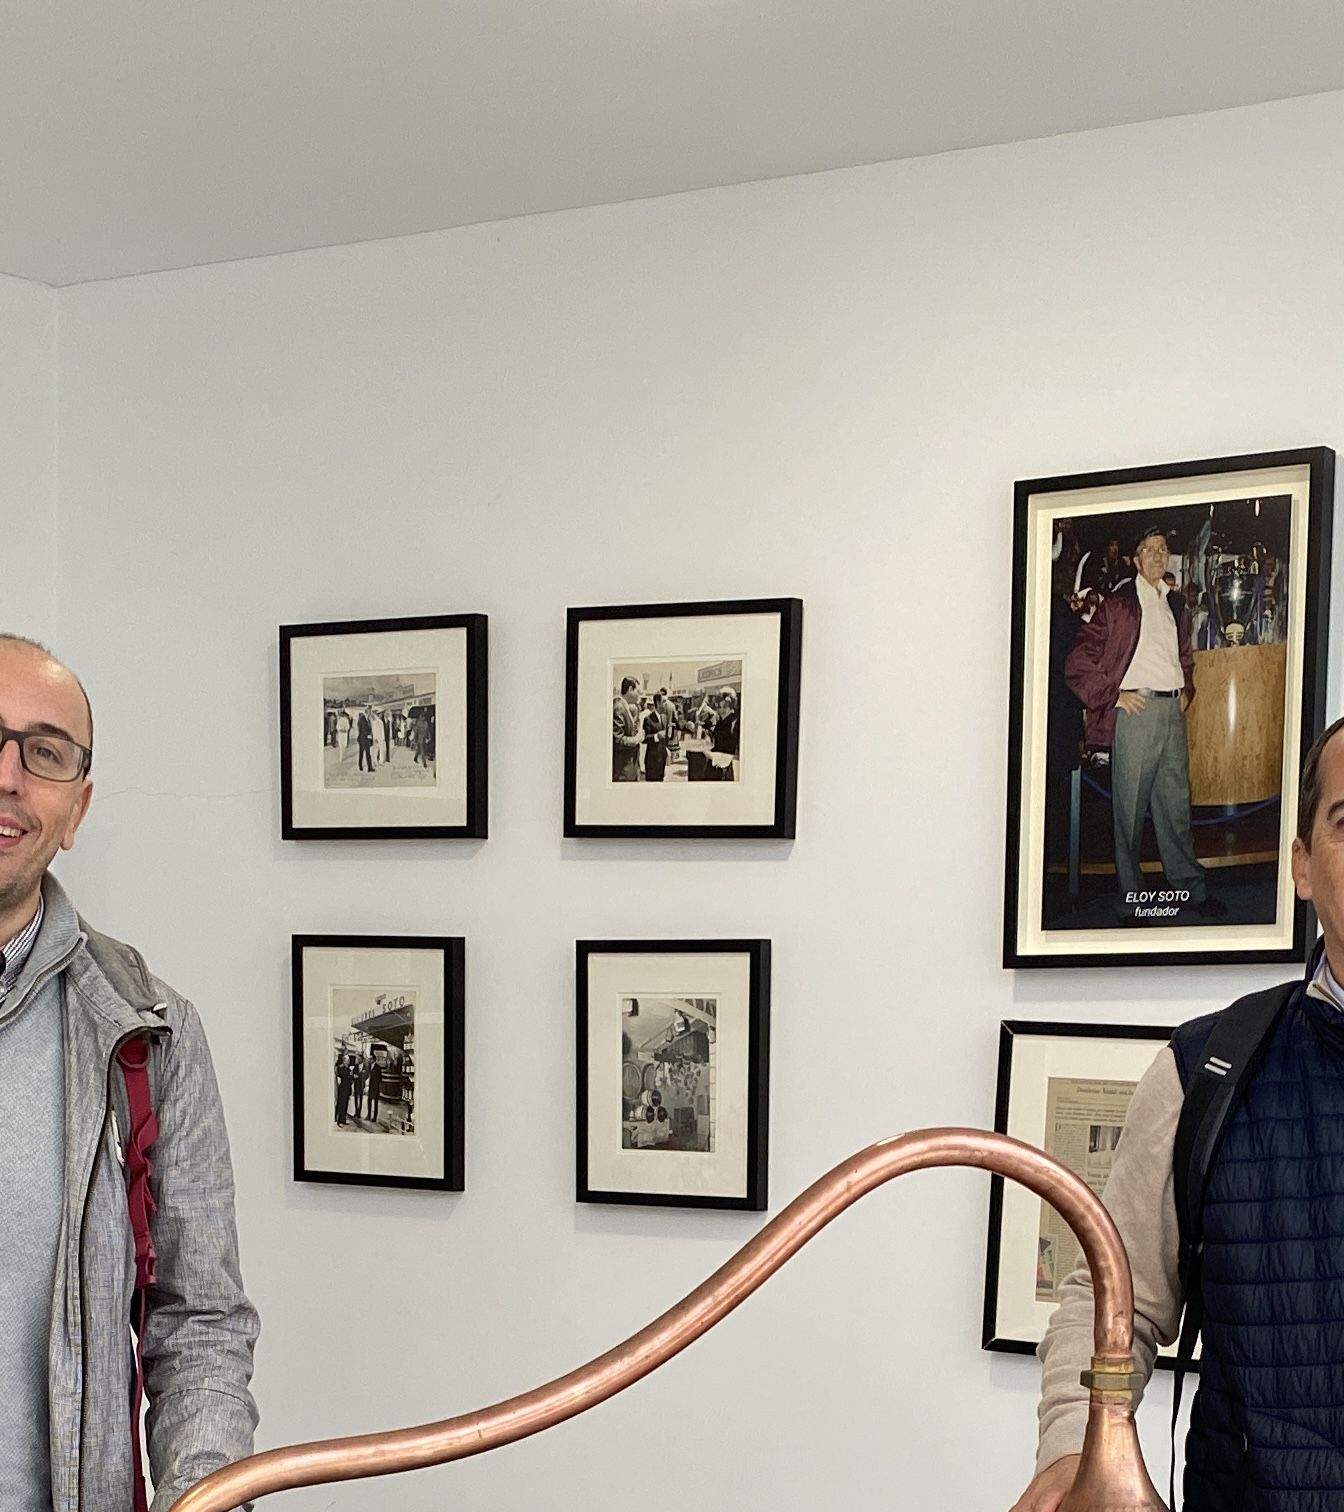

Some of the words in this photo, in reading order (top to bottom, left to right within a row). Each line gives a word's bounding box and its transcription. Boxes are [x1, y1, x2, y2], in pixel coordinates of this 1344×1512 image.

[1125, 891, 1156, 903] ELOY
[1157, 890, 1190, 902] SOTO
[1135, 906, 1180, 917] fundador
